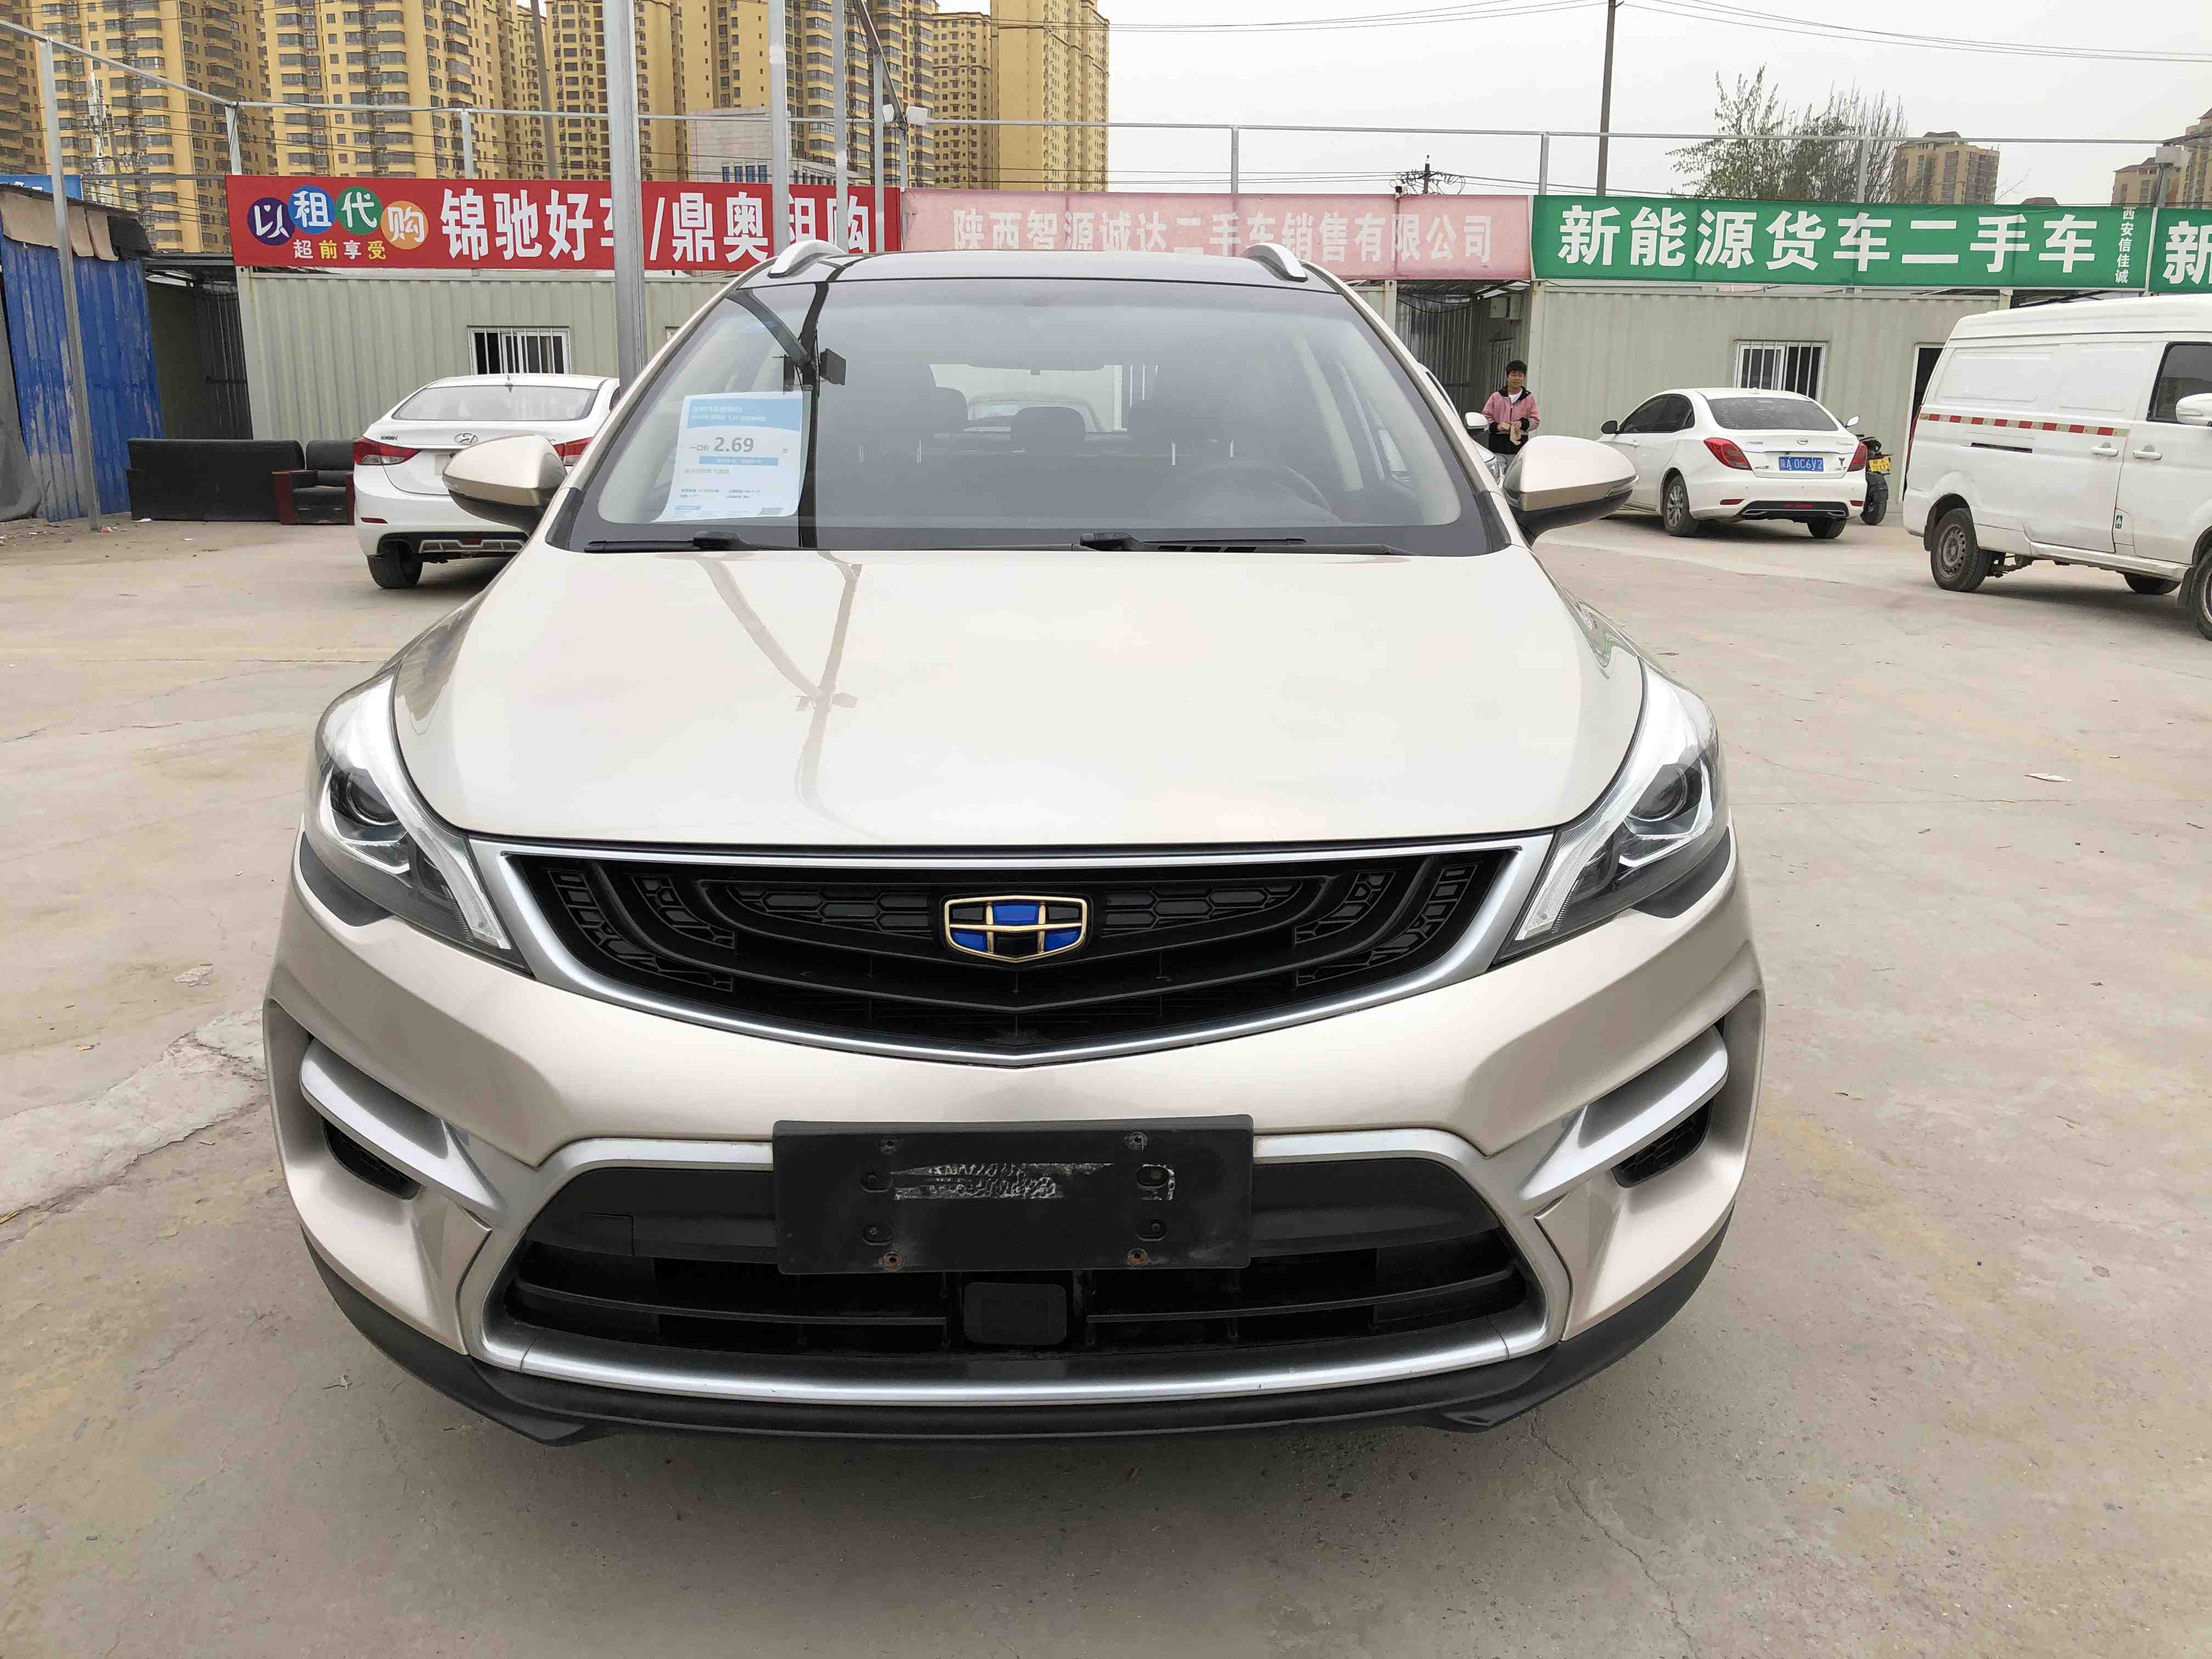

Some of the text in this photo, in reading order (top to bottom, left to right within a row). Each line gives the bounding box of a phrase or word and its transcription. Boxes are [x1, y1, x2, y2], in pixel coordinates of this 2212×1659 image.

[254, 189, 425, 244] 以租代购
[1557, 205, 2098, 274] 新能源货车二手车
[292, 239, 387, 261] 超前享受
[2114, 206, 2137, 284] 西安信佳诚
[714, 437, 754, 453] 2.69
